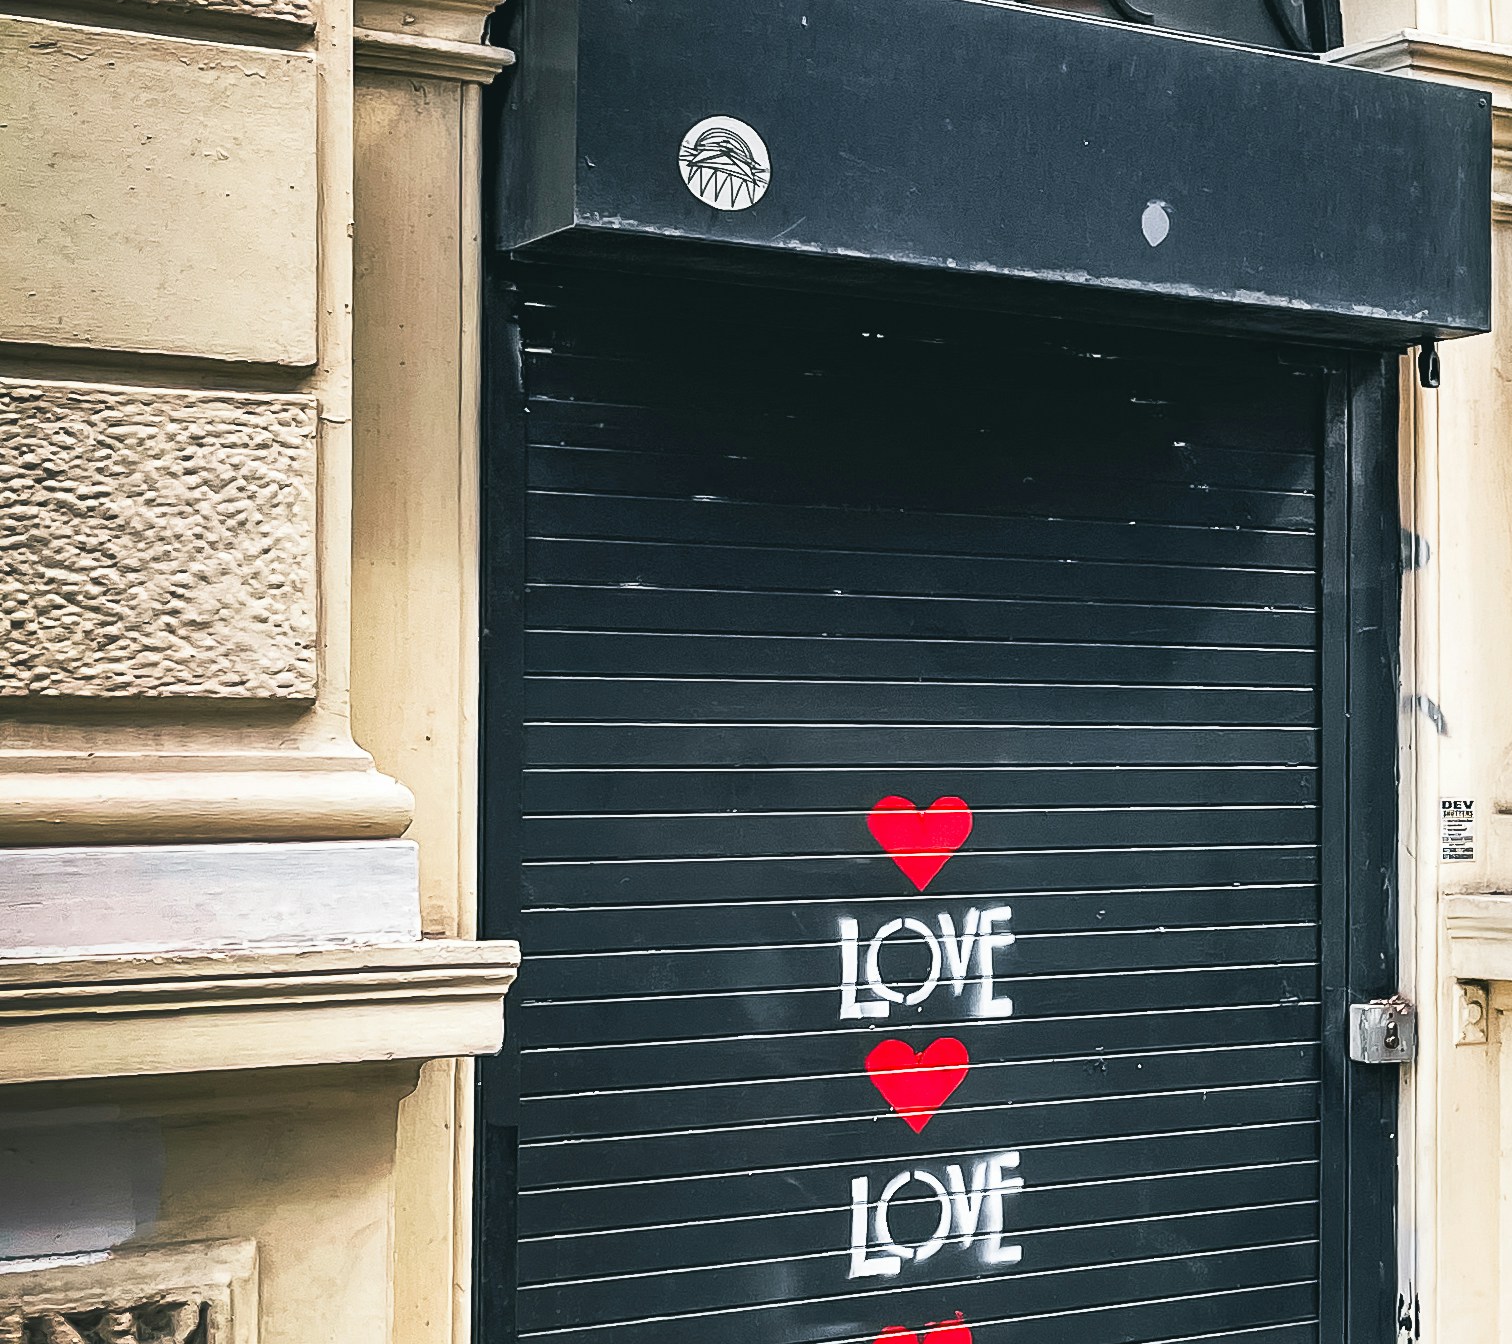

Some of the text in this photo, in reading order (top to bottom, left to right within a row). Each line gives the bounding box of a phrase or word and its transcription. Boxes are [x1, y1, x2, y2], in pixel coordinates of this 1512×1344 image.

[1442, 800, 1474, 809] DEV
[839, 905, 1015, 1020] LOVE
[847, 1150, 1024, 1279] LOVE
